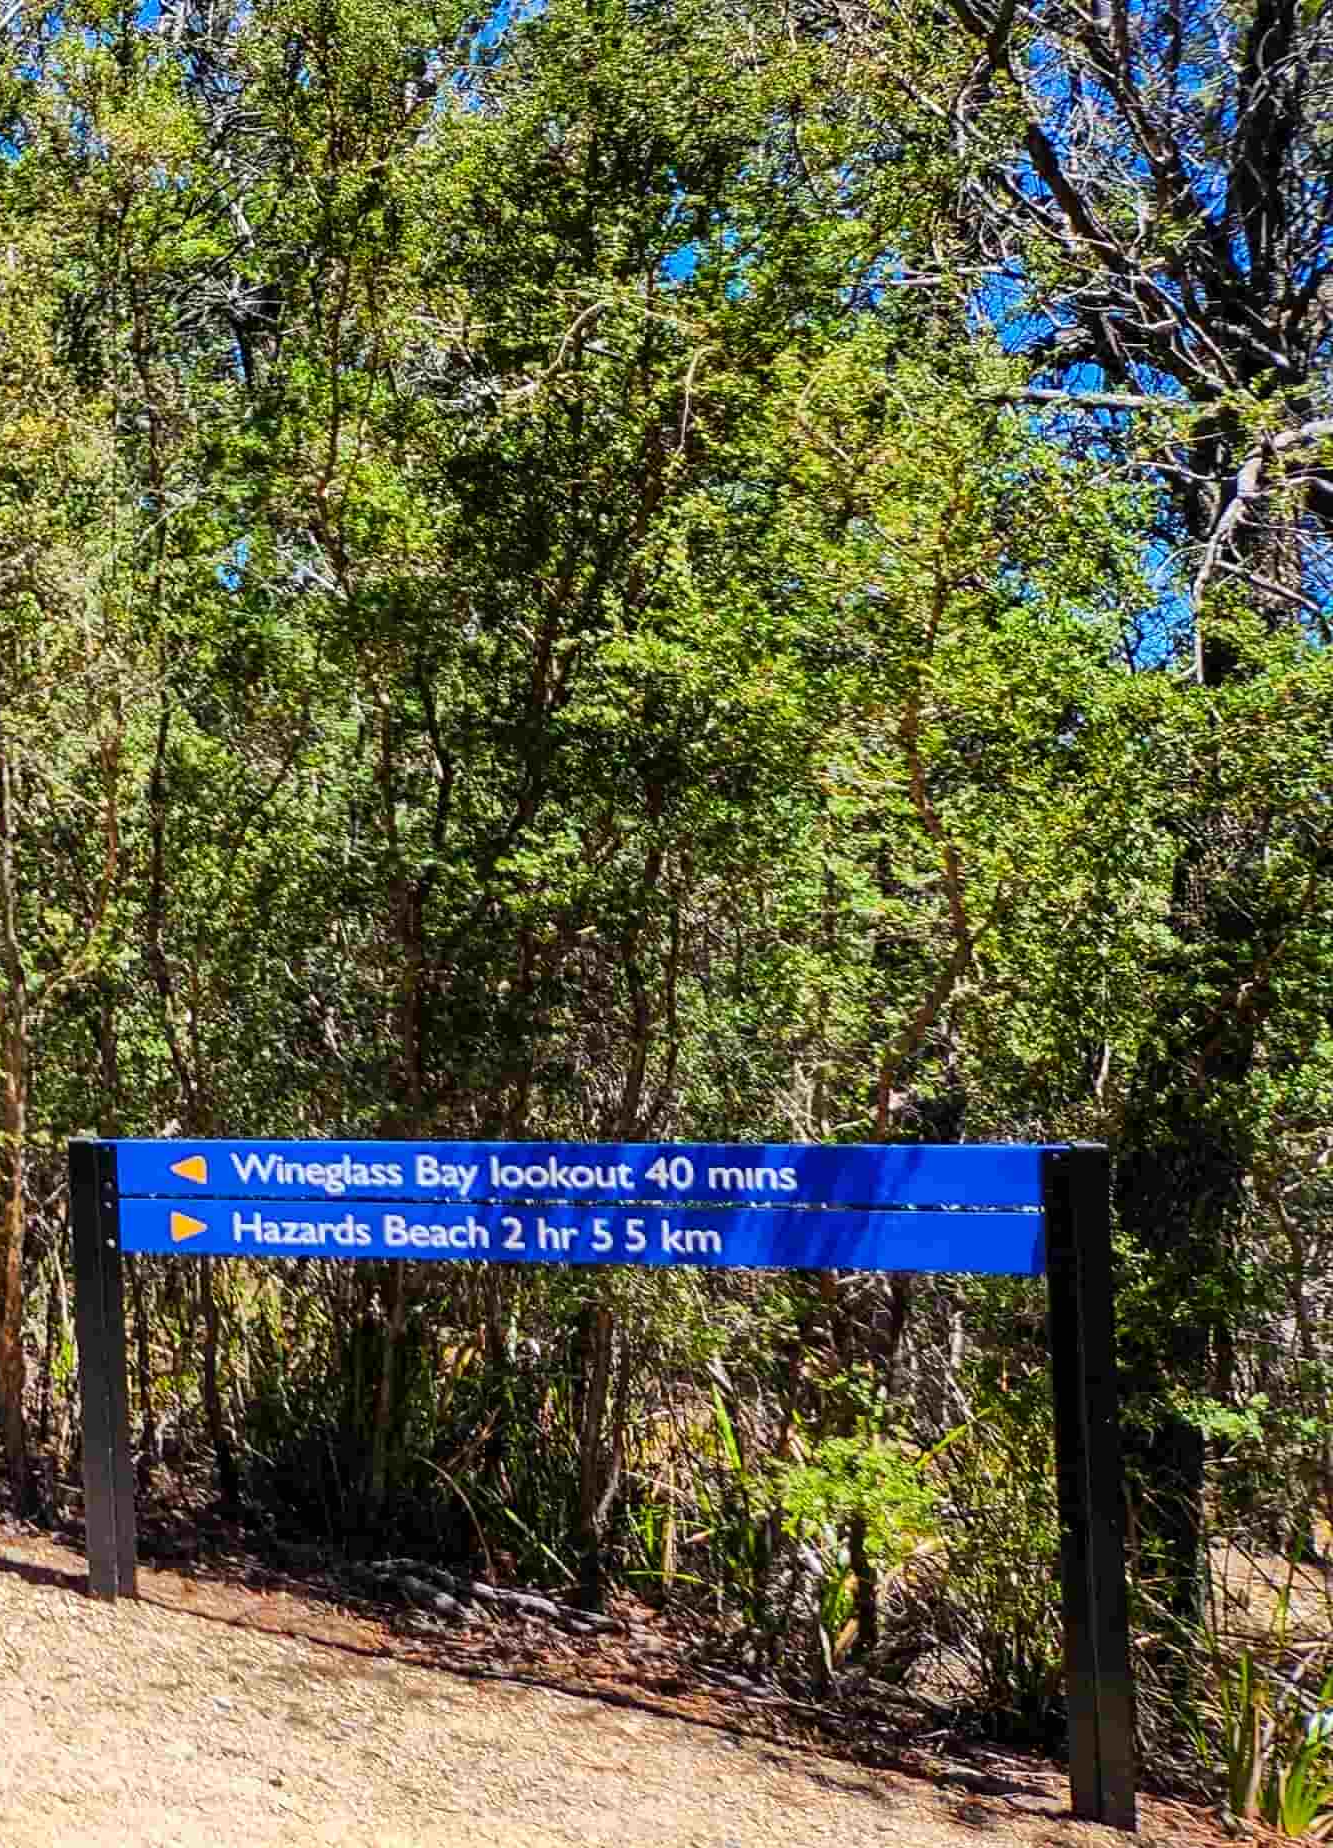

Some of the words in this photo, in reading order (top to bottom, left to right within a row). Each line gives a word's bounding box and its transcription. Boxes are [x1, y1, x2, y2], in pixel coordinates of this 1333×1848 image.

[230, 1152, 403, 1196] Wineglass
[416, 1154, 478, 1197] Bay
[490, 1155, 635, 1189] lookout
[644, 1156, 694, 1190] 40
[708, 1166, 798, 1191] mins
[233, 1211, 372, 1246] Hazards
[384, 1214, 490, 1249] Beach
[502, 1216, 526, 1249] 2
[537, 1217, 579, 1250] hr
[661, 1219, 722, 1253] km
